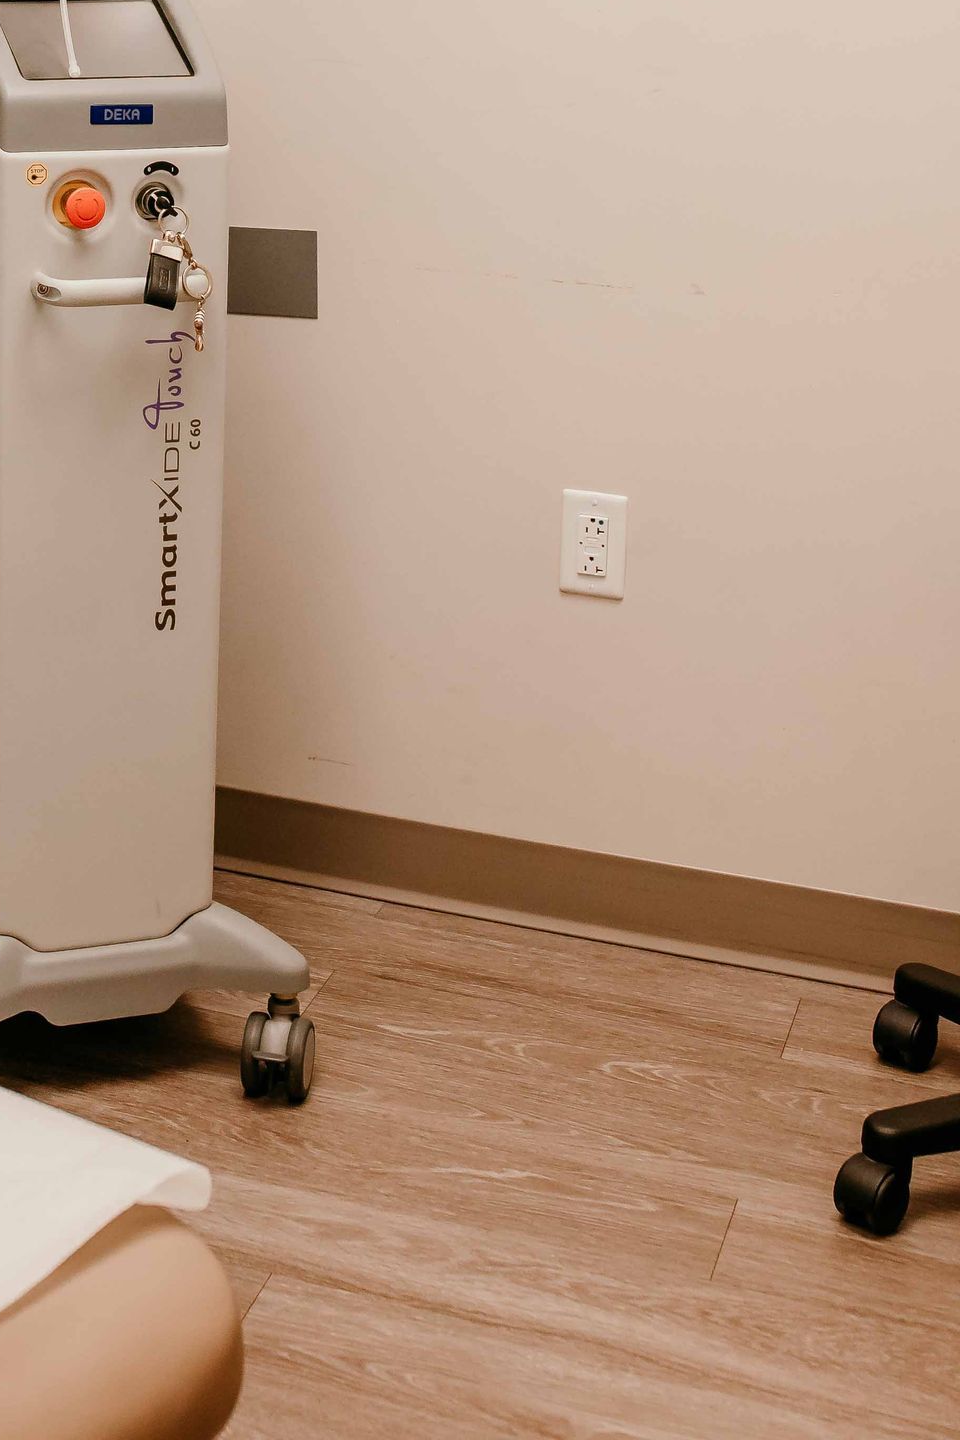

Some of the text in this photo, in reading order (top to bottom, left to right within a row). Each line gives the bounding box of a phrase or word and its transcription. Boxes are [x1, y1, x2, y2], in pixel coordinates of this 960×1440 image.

[103, 108, 140, 121] DEKA
[142, 331, 197, 430] Touch
[189, 418, 202, 450] C 60
